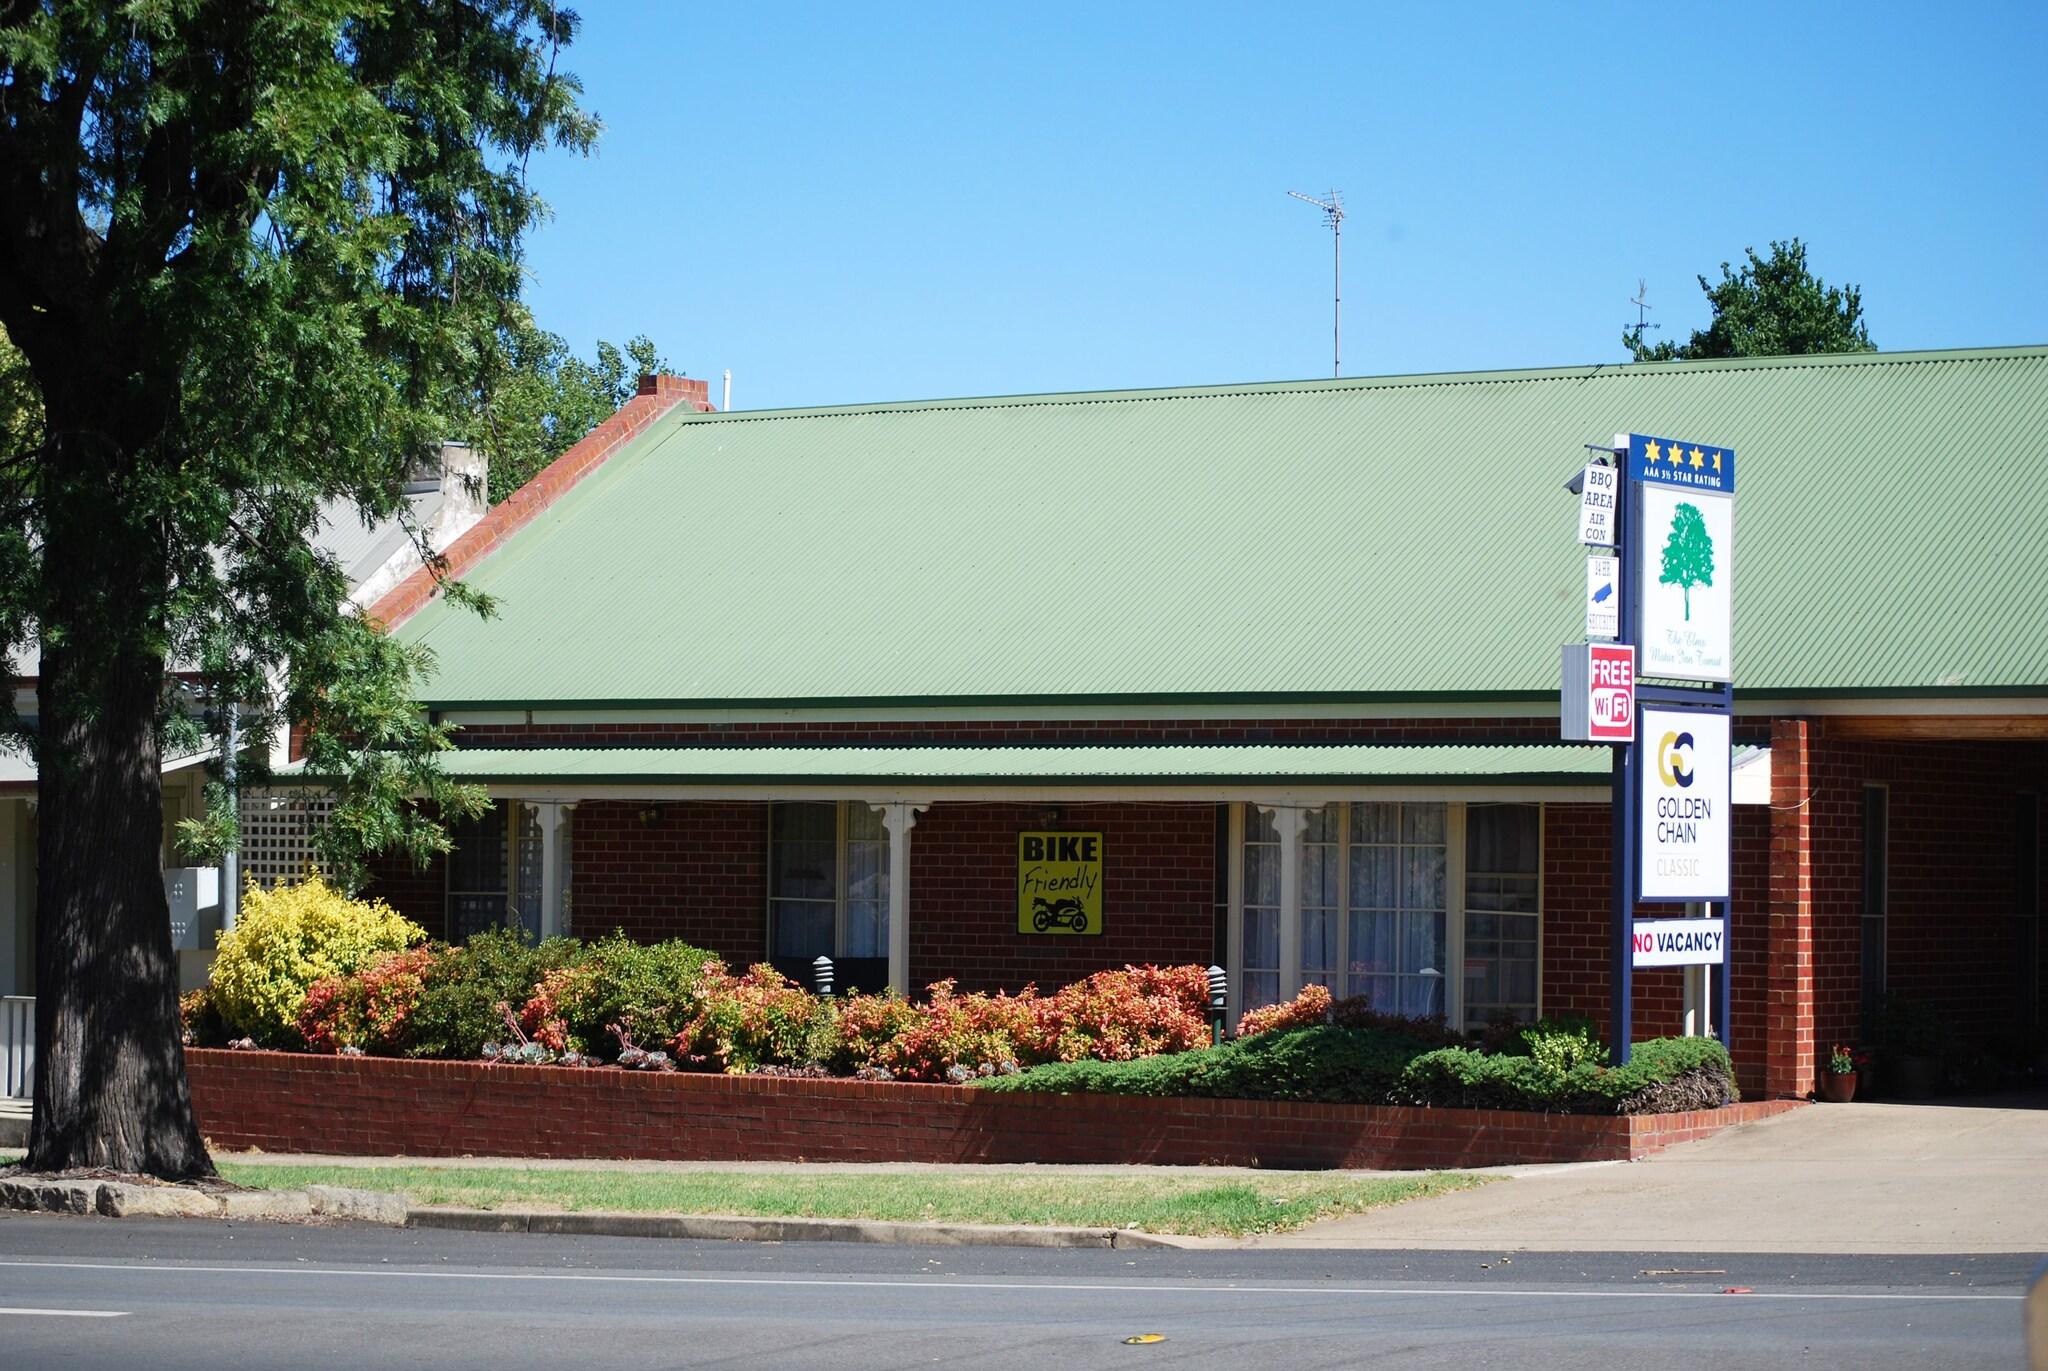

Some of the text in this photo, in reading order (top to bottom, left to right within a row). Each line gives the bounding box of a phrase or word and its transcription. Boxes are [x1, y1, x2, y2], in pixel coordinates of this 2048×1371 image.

[1590, 471, 1613, 489] BBQ
[1644, 466, 1659, 478] AAA
[1673, 471, 1692, 483] STAR
[1694, 474, 1721, 487] RATING
[1585, 491, 1613, 508] AREA
[1589, 513, 1605, 525] AIR
[1585, 528, 1606, 541] CON
[1591, 659, 1631, 686] FREE
[1657, 797, 1711, 819] GOLDEN
[1657, 821, 1697, 843] CHAIN
[1023, 836, 1098, 861] BIKE
[1656, 858, 1700, 877] CLASSIC
[1023, 864, 1098, 899] Friendly
[1633, 931, 1722, 952] NO VACANCY
